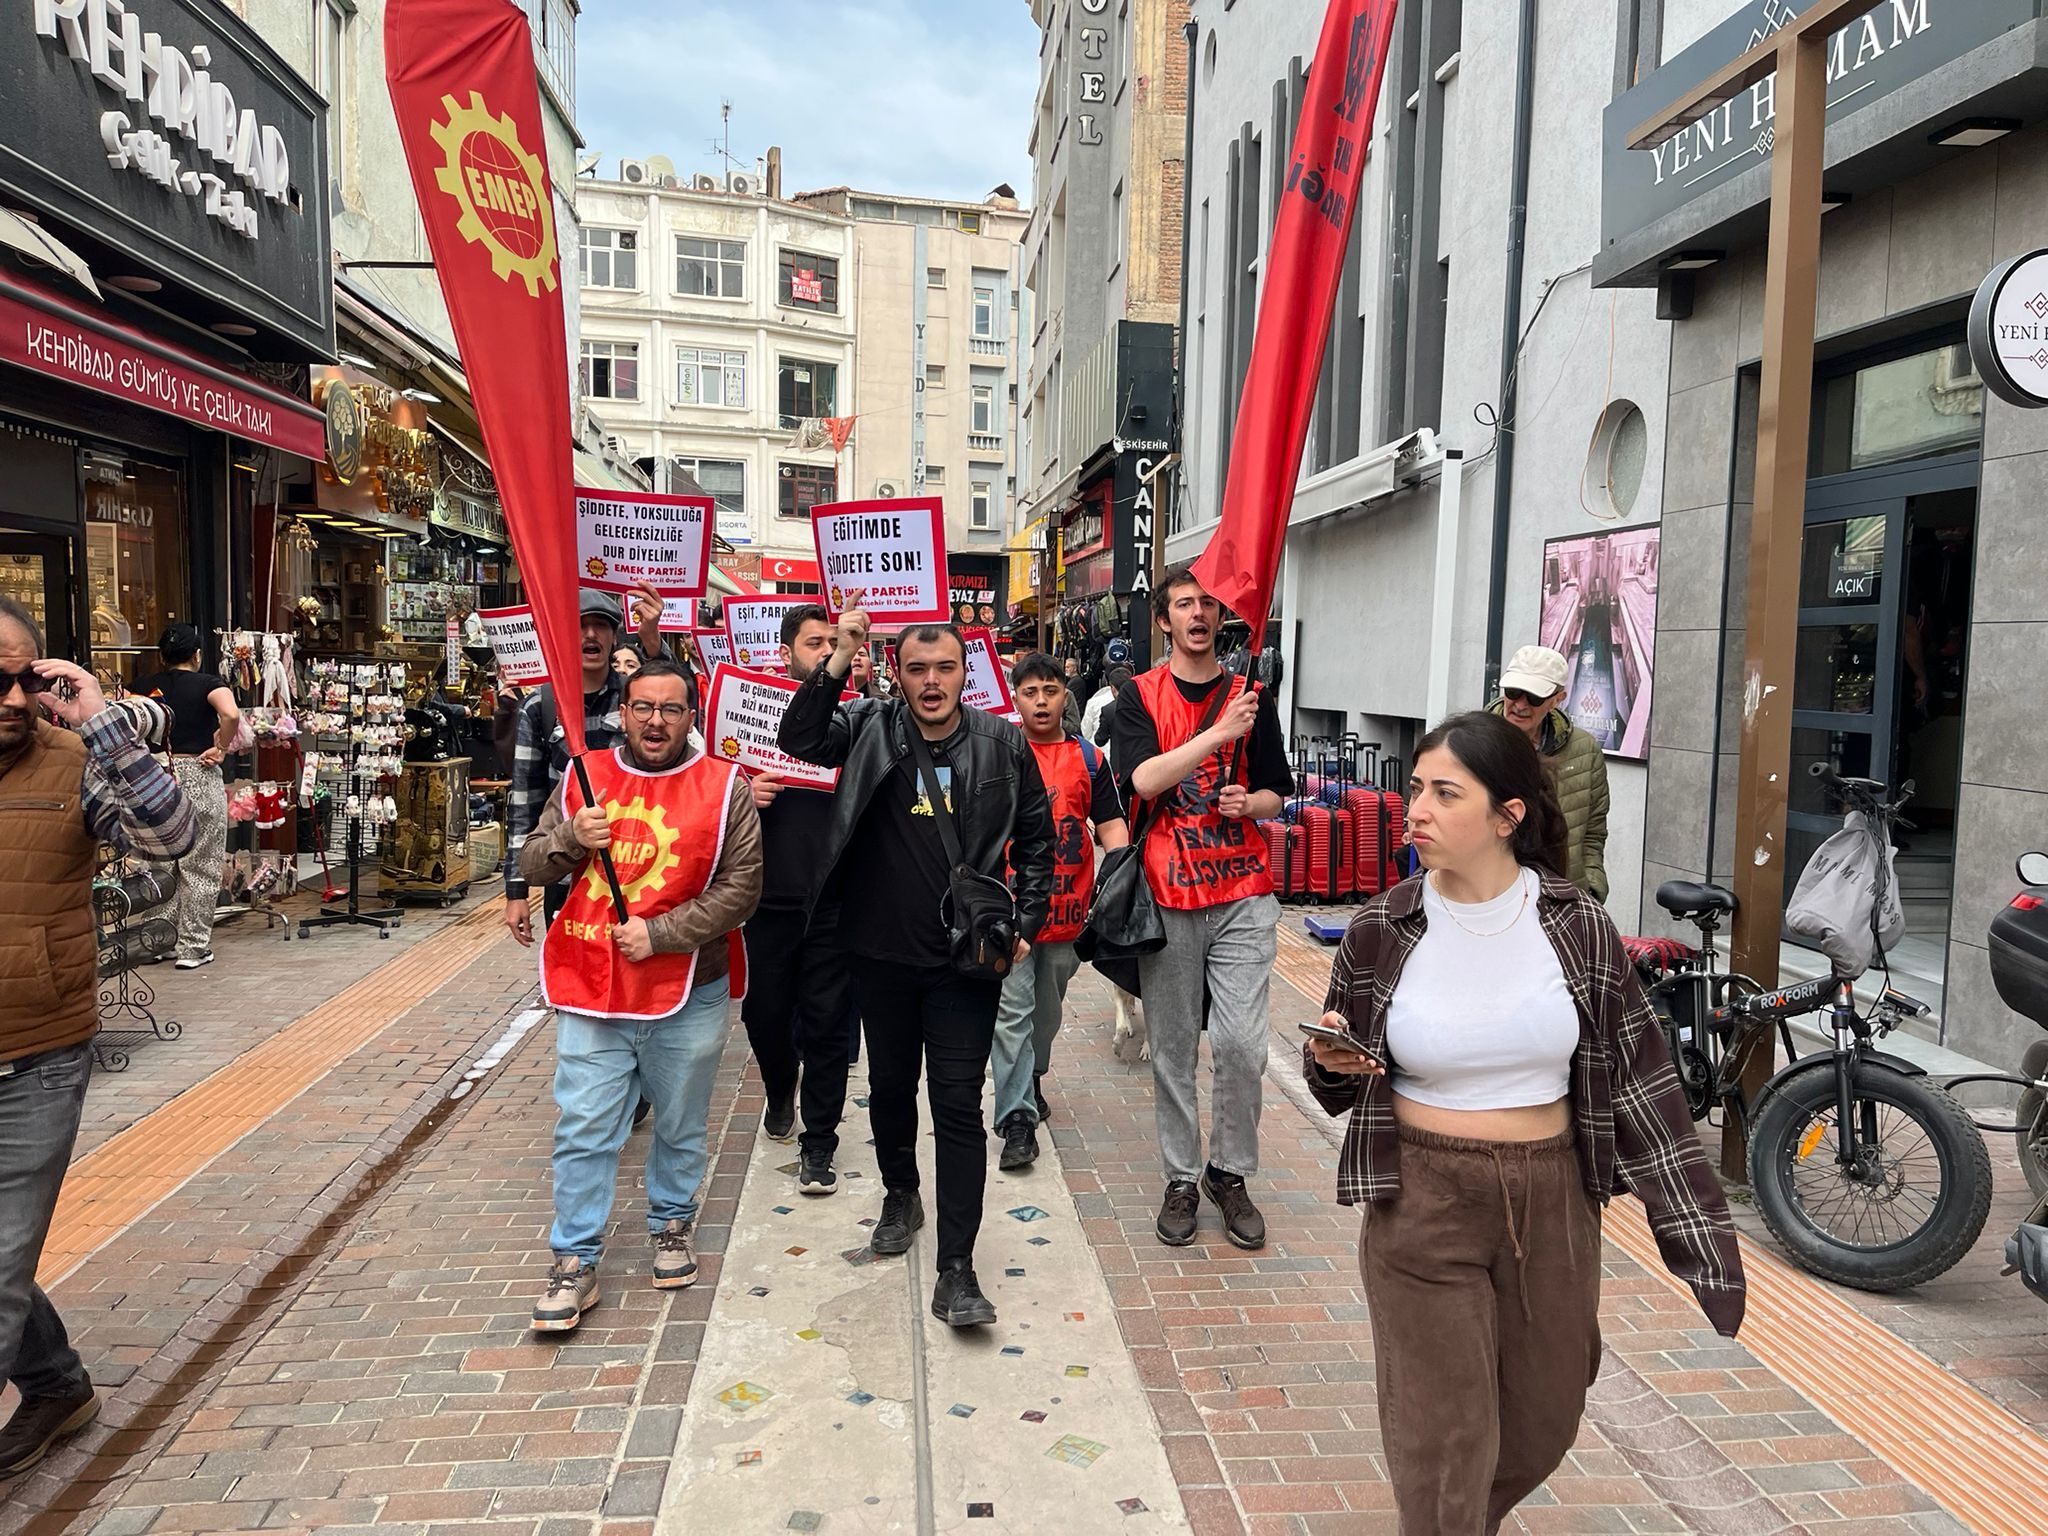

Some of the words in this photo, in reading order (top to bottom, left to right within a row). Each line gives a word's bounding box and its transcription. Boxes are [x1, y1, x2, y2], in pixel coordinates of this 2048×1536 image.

[465, 166, 537, 221] EMEP
[1999, 322, 2039, 340] YENİ
[27, 322, 114, 383] KEHRİBAR
[119, 358, 178, 410] GÜMÜŞ
[181, 380, 201, 412] VE
[204, 390, 242, 426] ÇELİK
[245, 403, 273, 436] TAKI
[579, 499, 629, 519] ŞİDDETE,
[634, 506, 702, 523] YOKSULLUĞA
[594, 523, 683, 543] GELECEKSİZLİĞE
[833, 515, 901, 542] EĞİTİMDE
[603, 544, 624, 560] DUR
[629, 545, 678, 563] DİYELİM!
[717, 558, 739, 567] ARAY
[614, 563, 644, 575] EMEK
[827, 551, 873, 582] ŞİDDETE
[880, 550, 922, 572] SON!
[950, 589, 975, 603] EYAZ
[1834, 577, 1865, 597] AÇIK
[738, 604, 758, 623] EŞİT,
[734, 629, 770, 645] NİTELİKLİ
[740, 682, 751, 694] BU
[752, 684, 791, 707] ÇÜRÜMÜŞ
[741, 699, 757, 711] BİZİ
[725, 710, 770, 732] YAKMASINA,
[737, 727, 751, 741] İZİN
[747, 745, 775, 761] EMEK
[611, 840, 656, 865] MEP
[1760, 982, 1819, 1009] ROXFORM
